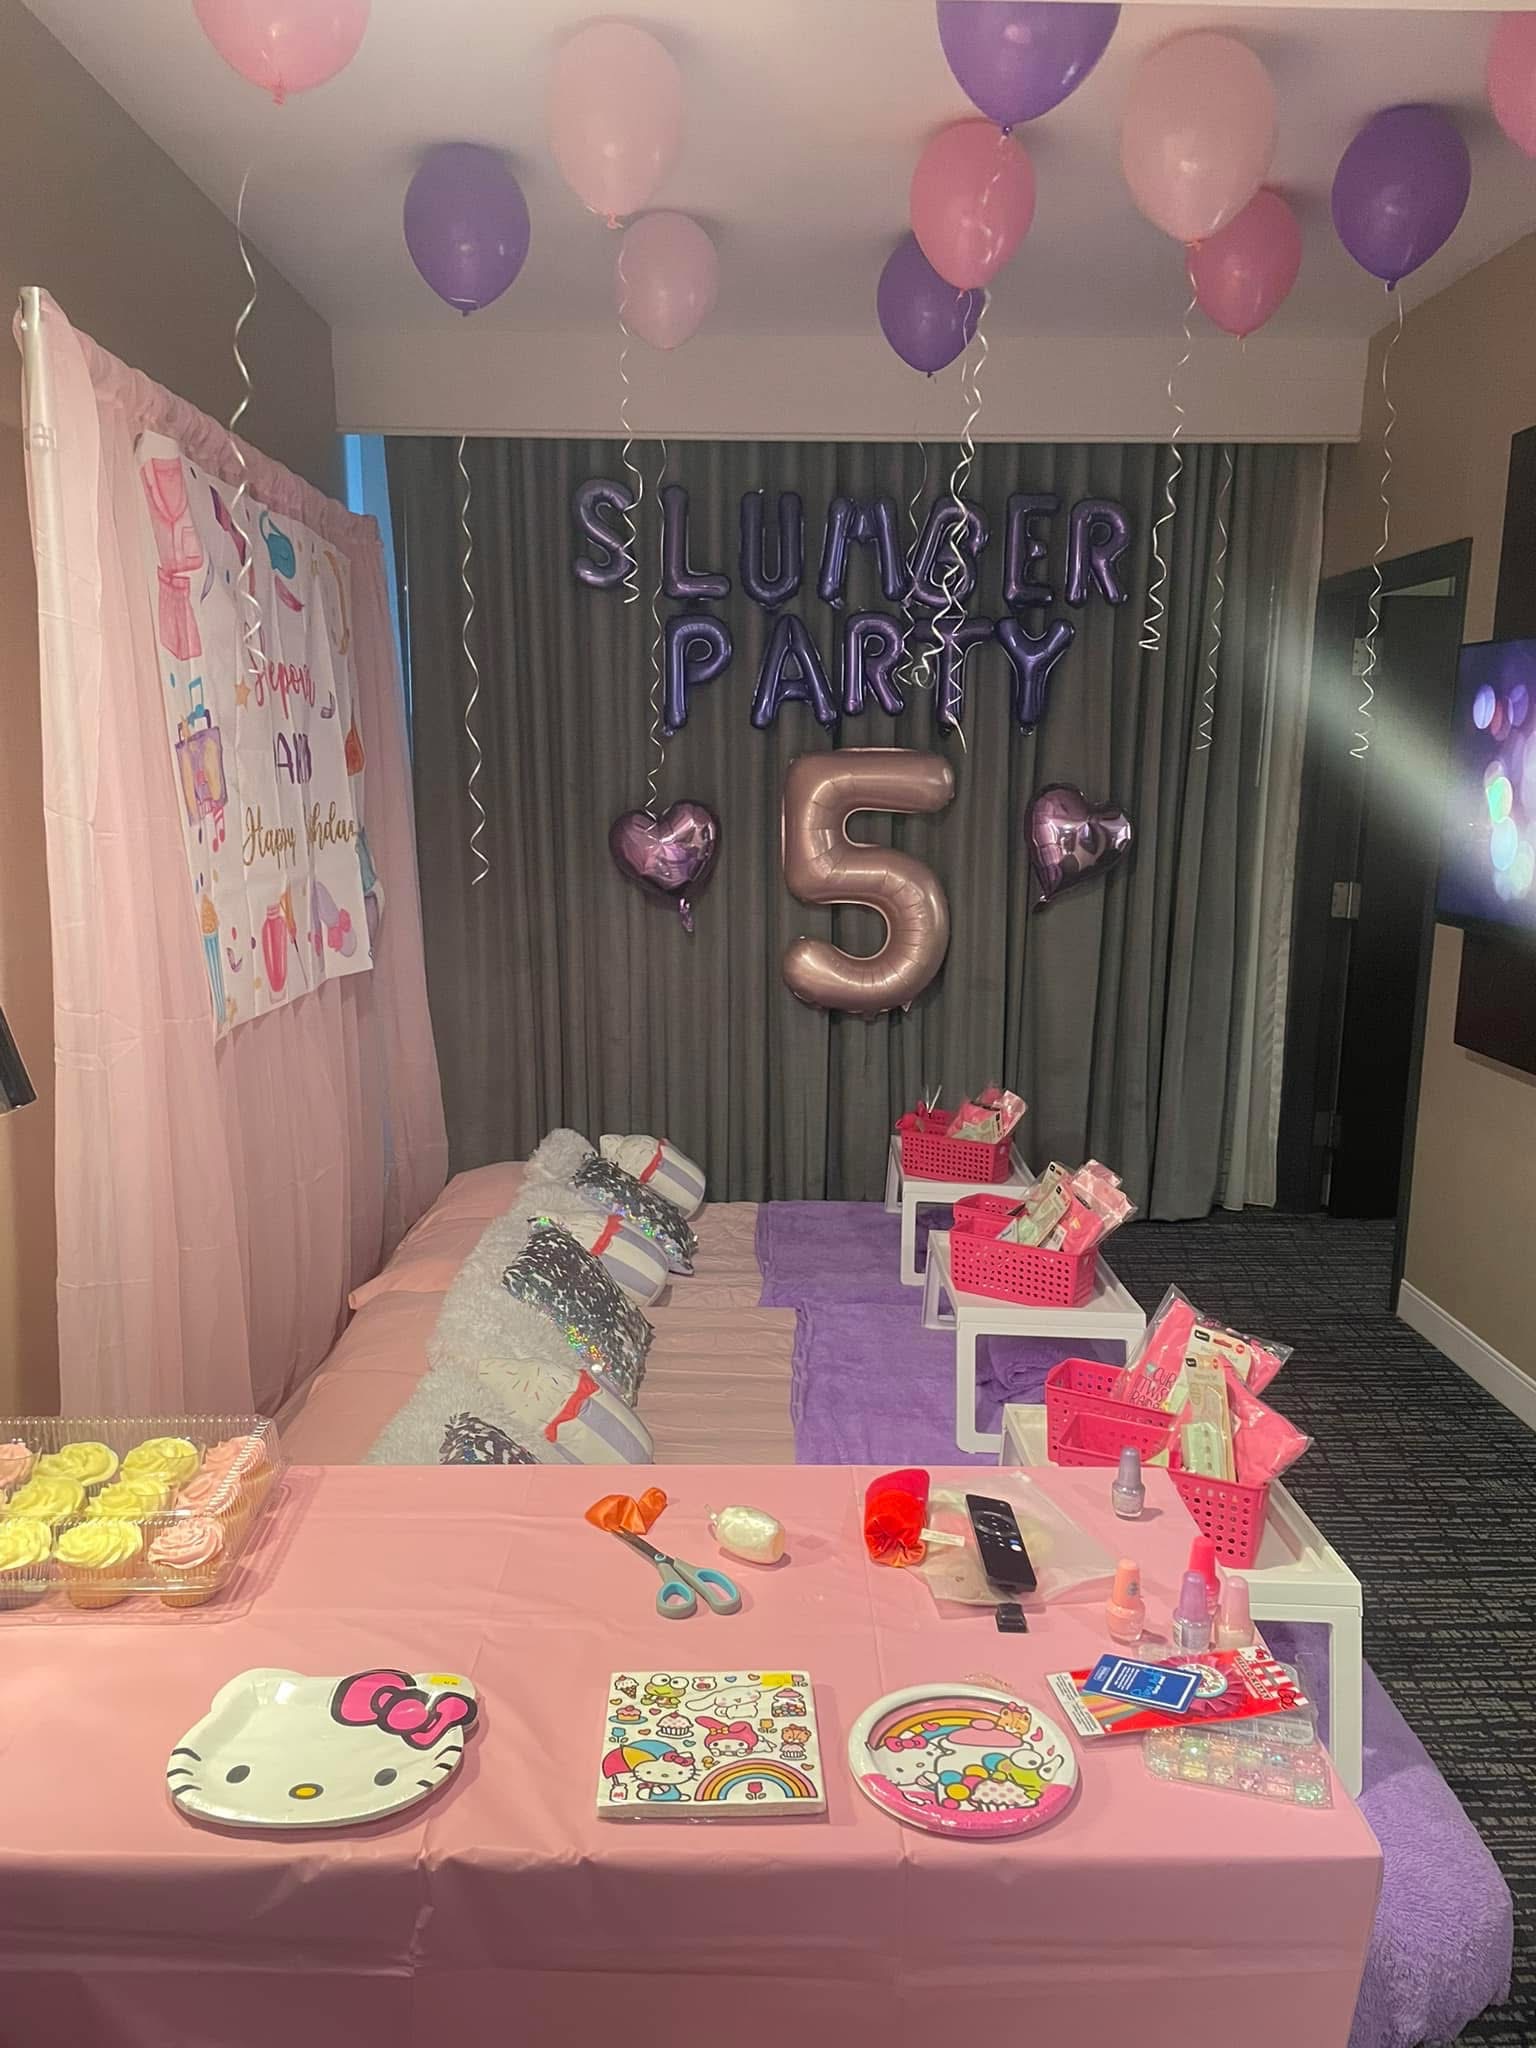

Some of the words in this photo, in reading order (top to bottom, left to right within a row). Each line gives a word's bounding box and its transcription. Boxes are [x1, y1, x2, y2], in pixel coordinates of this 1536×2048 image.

[573, 478, 1131, 608] SLUMBER
[662, 613, 1078, 736] PARTY
[241, 805, 297, 870] Happy
[782, 747, 957, 1016] 5
